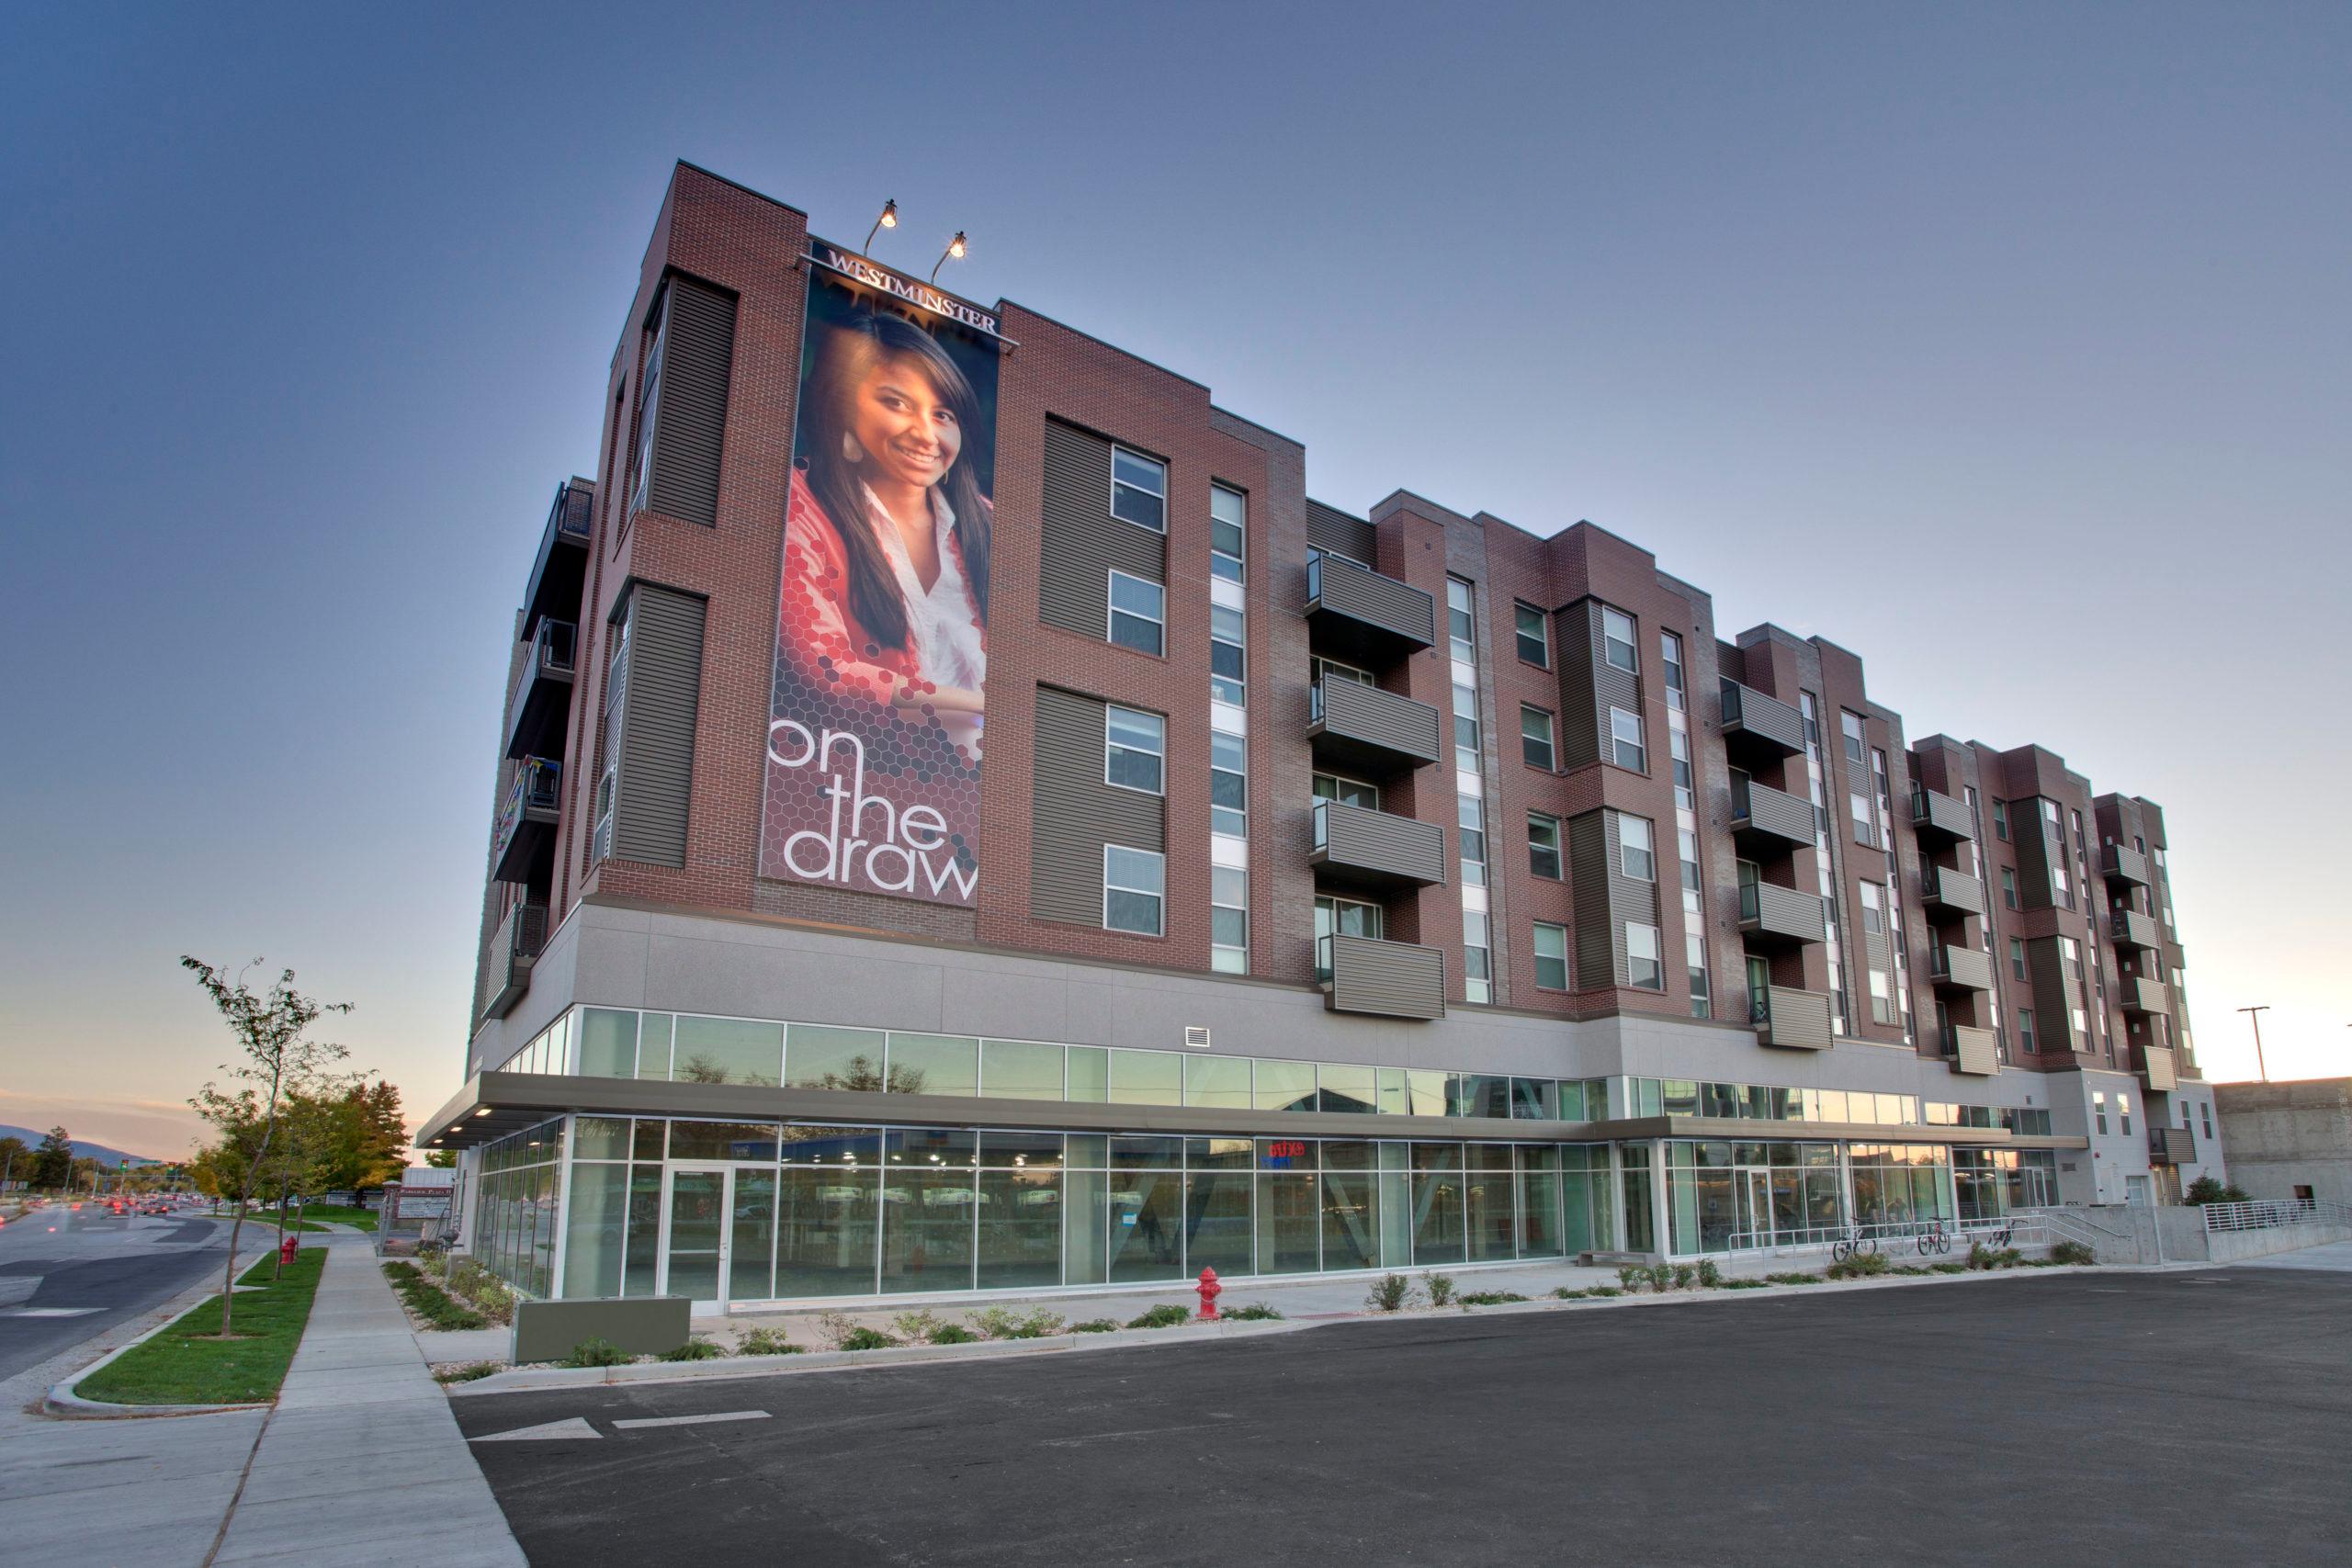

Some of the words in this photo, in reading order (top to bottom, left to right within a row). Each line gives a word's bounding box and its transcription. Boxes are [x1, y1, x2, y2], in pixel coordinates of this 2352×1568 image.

[829, 250, 997, 334] WESTMINSTER
[770, 719, 864, 810] on
[825, 774, 948, 851] the
[784, 831, 978, 900] draw
